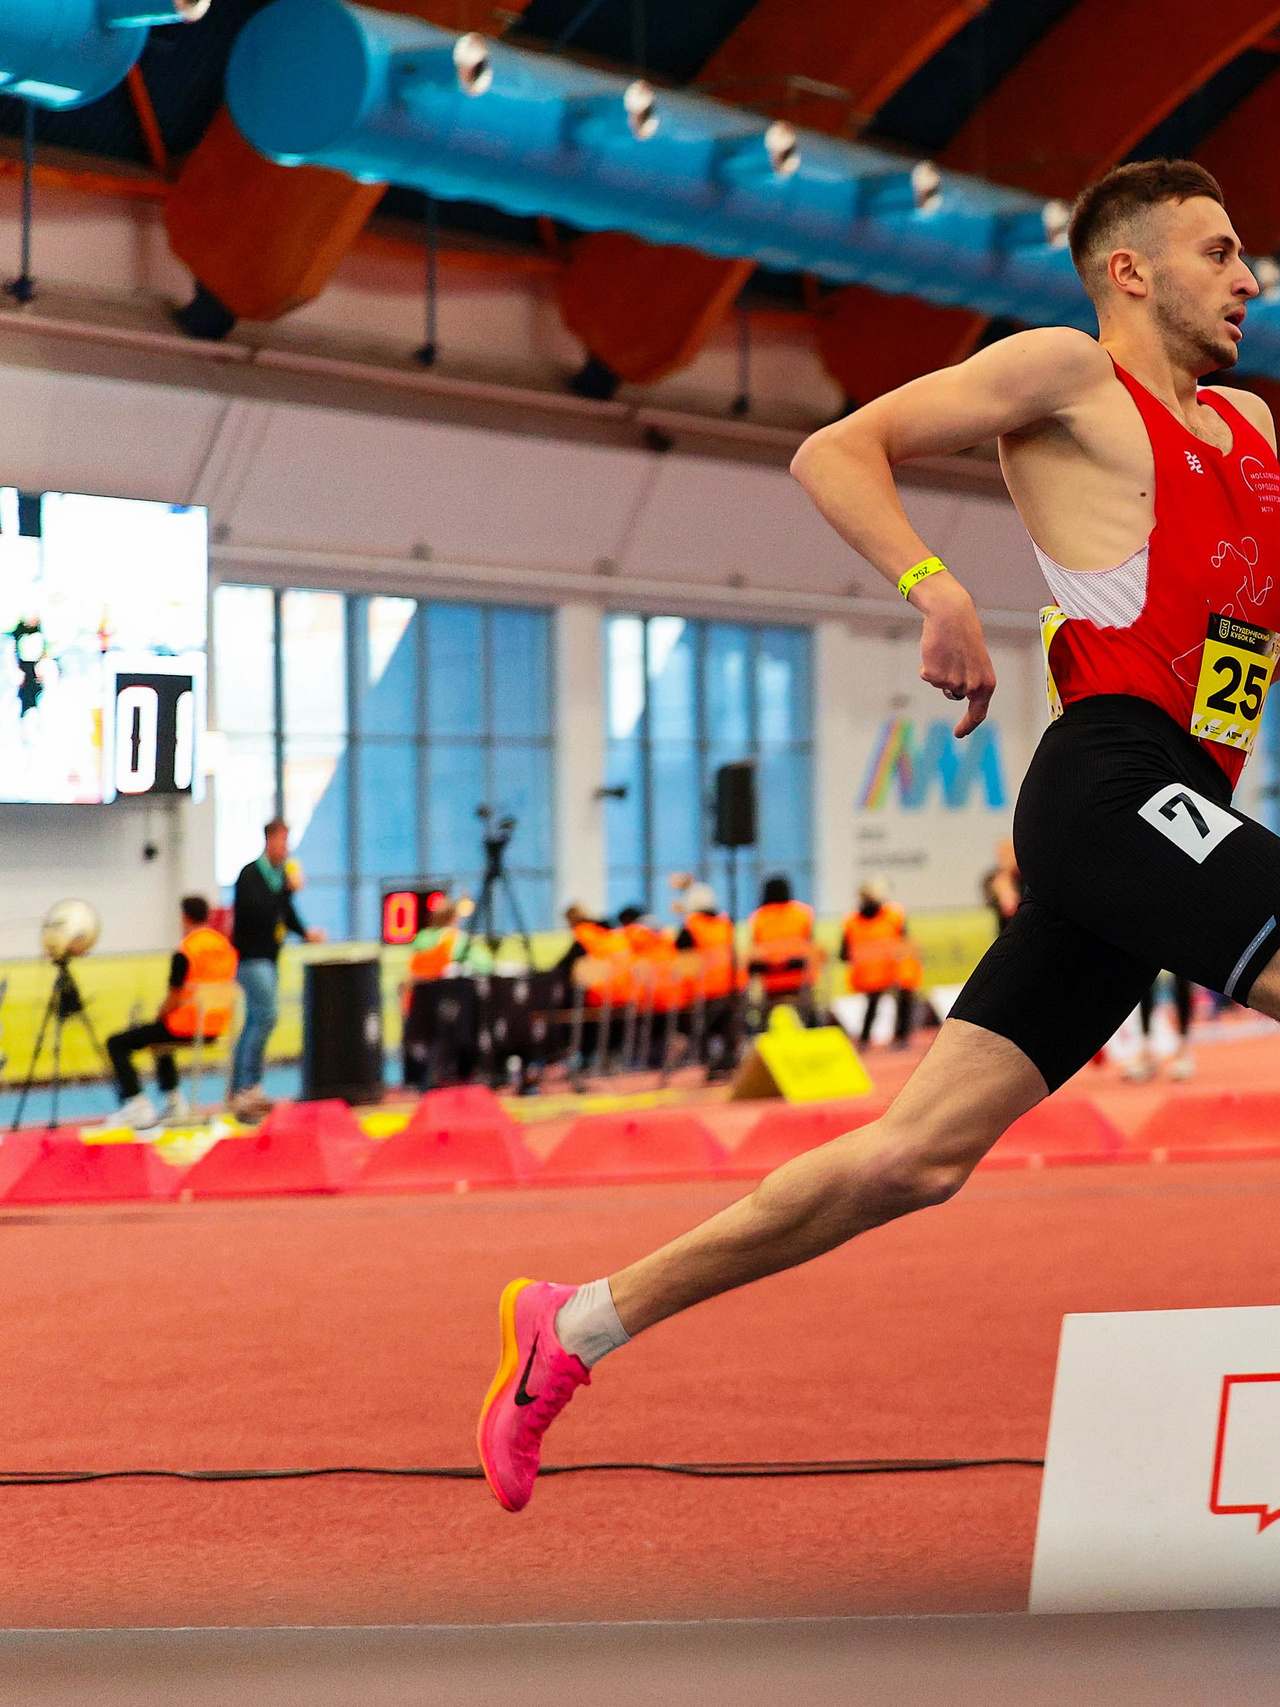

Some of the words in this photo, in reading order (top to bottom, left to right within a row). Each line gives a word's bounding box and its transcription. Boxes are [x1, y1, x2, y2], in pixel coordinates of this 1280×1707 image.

[1230, 631, 1249, 643] КУБОК
[1231, 625, 1270, 642] СТУДЕНЧЕСКИЙ
[1206, 656, 1268, 721] 25
[1158, 792, 1210, 839] 7
